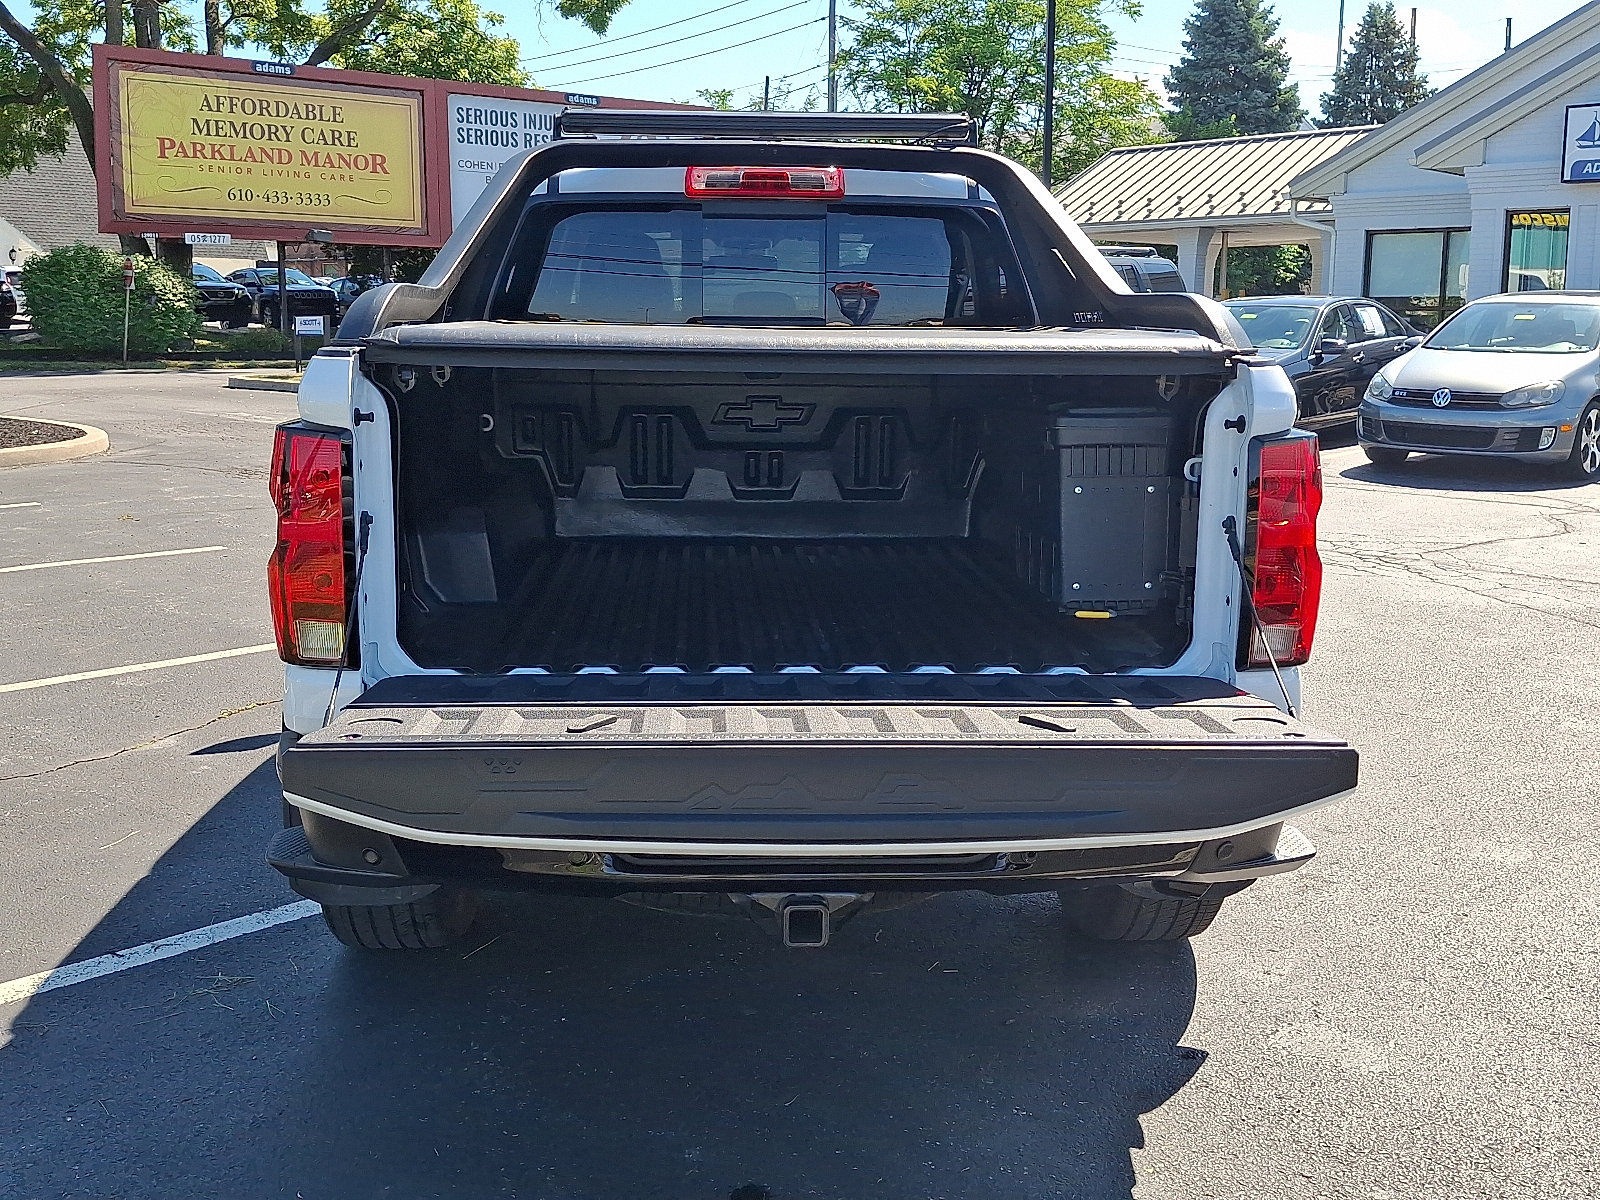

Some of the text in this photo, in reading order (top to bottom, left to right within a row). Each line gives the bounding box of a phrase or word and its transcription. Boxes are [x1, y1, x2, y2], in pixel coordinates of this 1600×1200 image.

[255, 63, 291, 75] adams
[199, 93, 345, 124] AFFORDABLE
[568, 94, 597, 105] adams
[456, 106, 519, 129] SERIOUS
[190, 117, 359, 149] MEMORY CARE
[456, 127, 553, 149] SERIOUS RES
[156, 136, 391, 176] PARKLAND MANOR
[198, 164, 356, 183] SENIOR LIVING CARE
